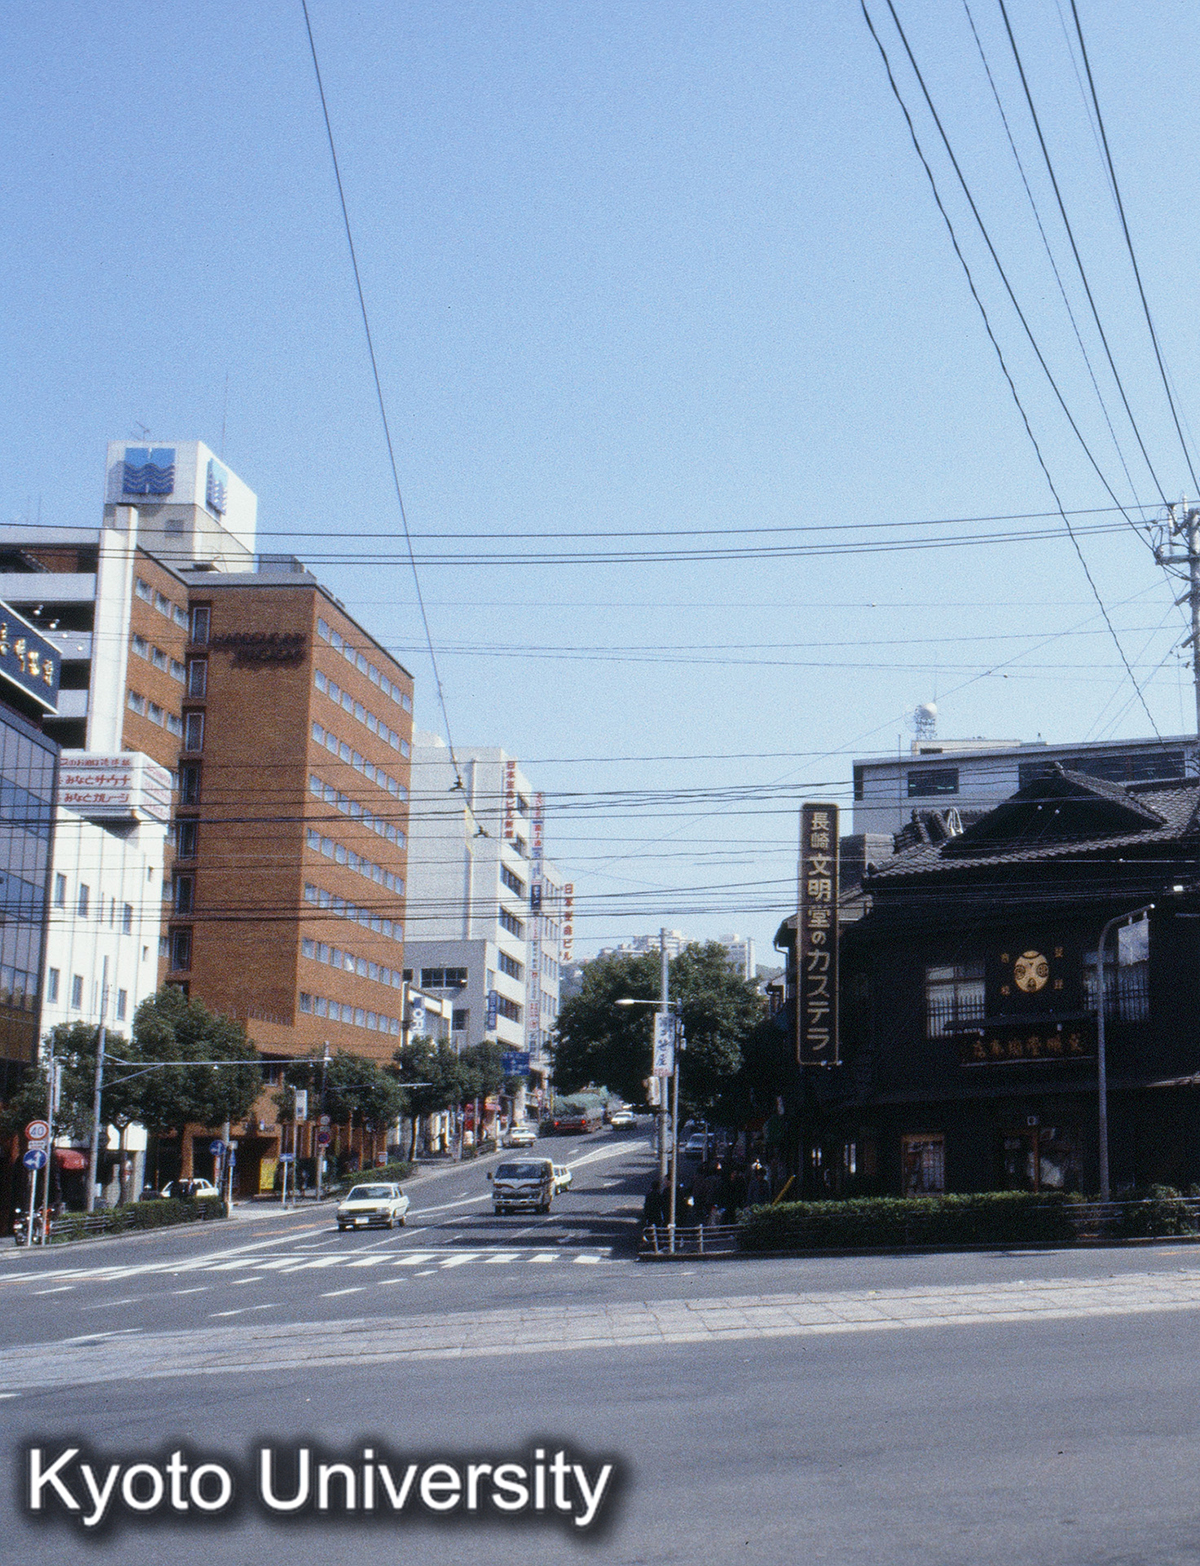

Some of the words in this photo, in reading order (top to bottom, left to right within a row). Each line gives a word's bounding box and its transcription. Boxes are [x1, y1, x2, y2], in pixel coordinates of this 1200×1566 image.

[563, 883, 575, 961] 日本生命ビル
[806, 811, 832, 1052] 長崎文明堂のカステラ
[30, 1126, 45, 1137] 40
